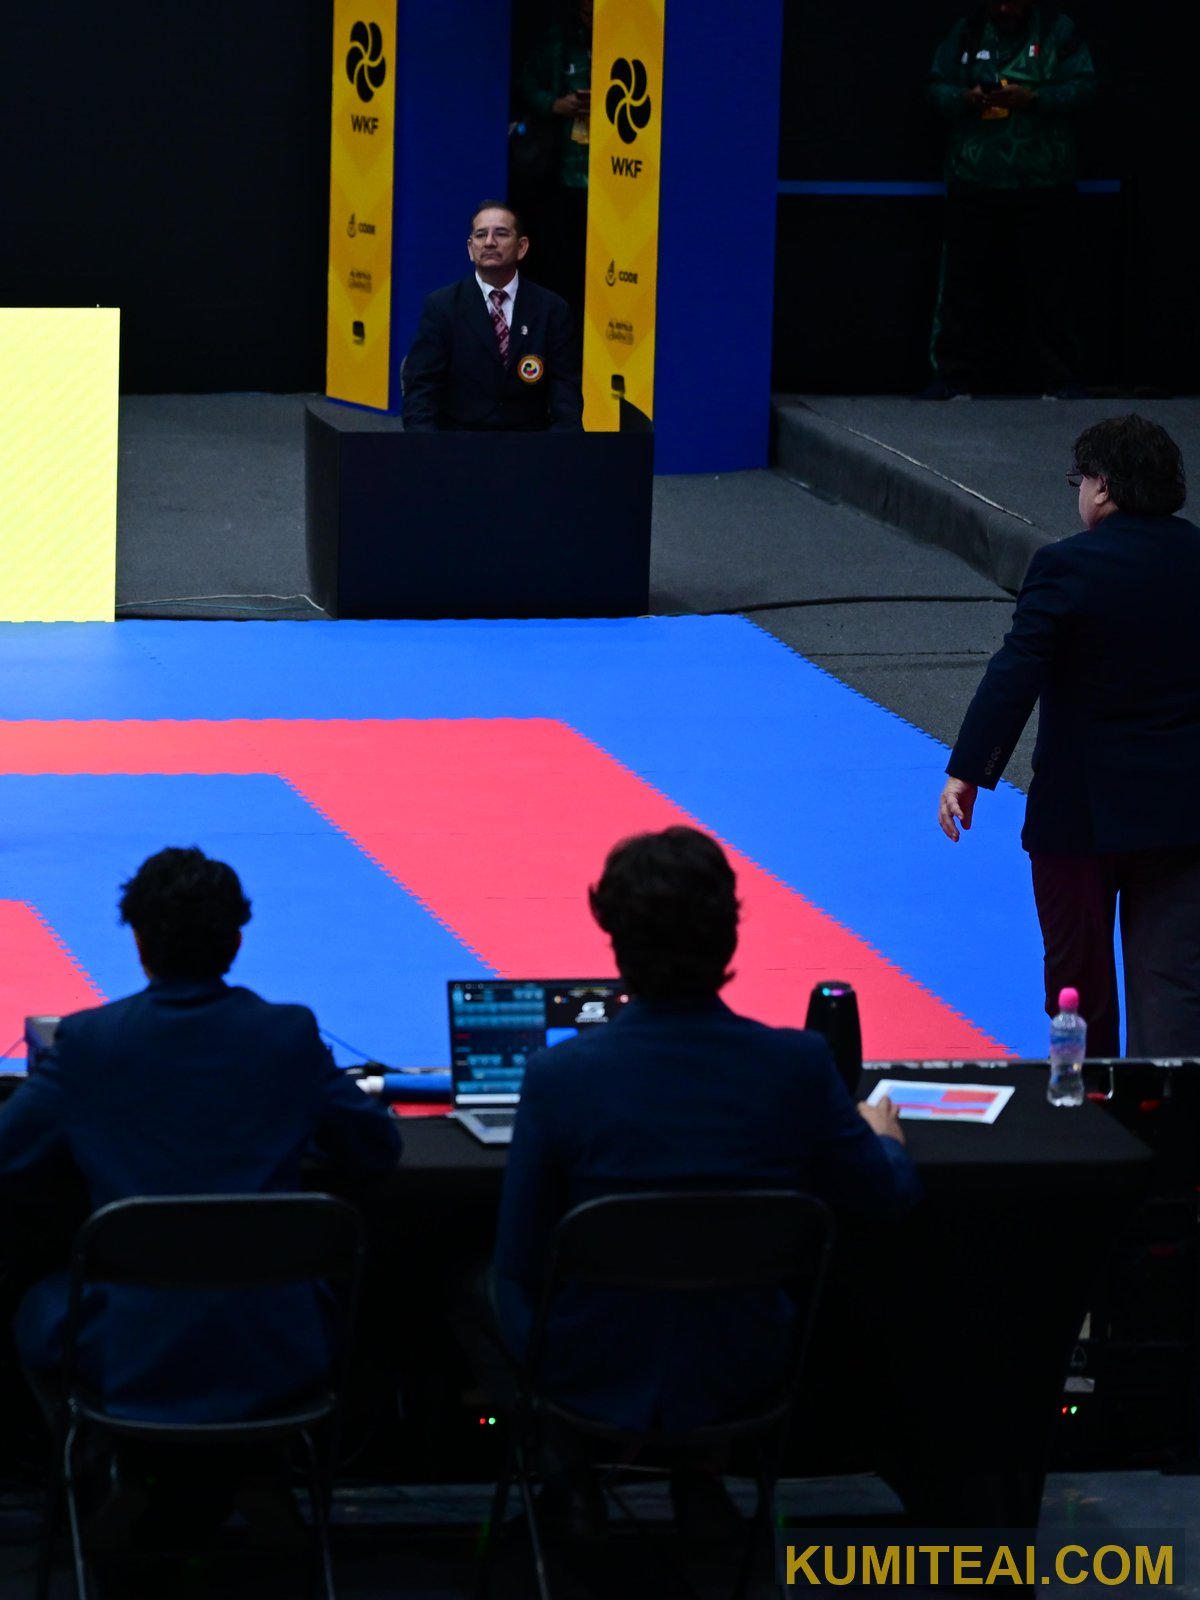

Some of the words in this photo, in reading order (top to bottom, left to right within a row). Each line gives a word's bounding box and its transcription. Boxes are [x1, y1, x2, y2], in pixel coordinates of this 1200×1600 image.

[351, 115, 379, 135] WKF
[611, 155, 642, 179] WKF
[618, 270, 638, 285] CODE
